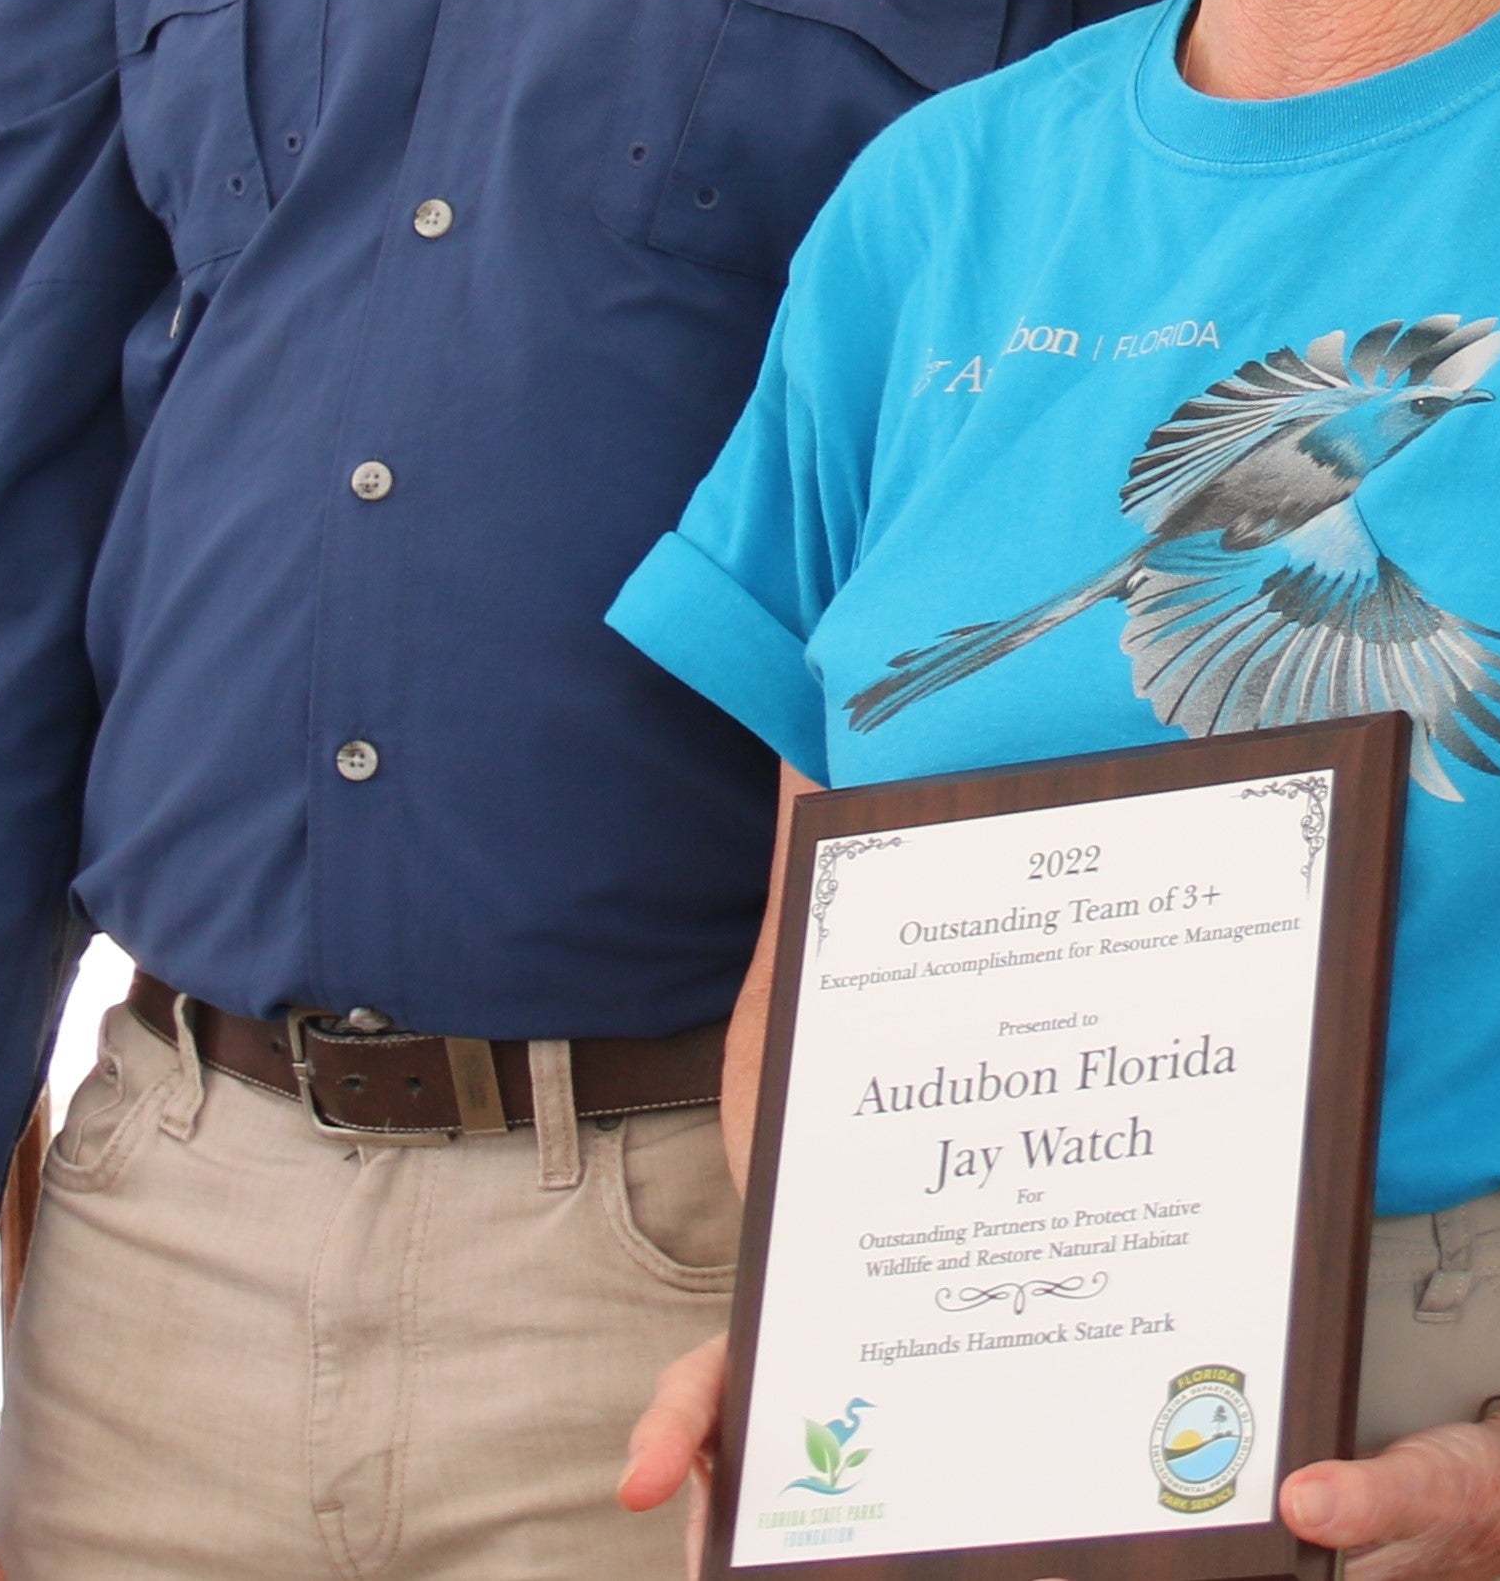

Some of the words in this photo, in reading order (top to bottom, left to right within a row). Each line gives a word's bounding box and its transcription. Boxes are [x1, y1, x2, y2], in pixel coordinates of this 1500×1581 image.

[1113, 320, 1221, 361] FLORIDA
[1028, 845, 1101, 880] 2022
[899, 906, 1060, 946] Outstanding
[1069, 898, 1139, 924] Team
[1148, 885, 1178, 914] of
[1182, 884, 1221, 910] 3+
[819, 962, 918, 991] Exceptional
[922, 947, 1063, 976] Accomplishment
[1067, 941, 1094, 959] for
[1099, 933, 1179, 955] Resource
[1184, 916, 1300, 944] Management
[998, 1012, 1077, 1036] Presented
[1082, 1013, 1098, 1027] to
[852, 1060, 1058, 1116] Audubon
[1076, 1034, 1236, 1091] Florida
[924, 1138, 1004, 1195] Jay
[1019, 1115, 1154, 1169] Watch
[1017, 1188, 1044, 1205] For
[859, 1224, 967, 1250] Outstanding
[973, 1219, 1046, 1238] Partners
[1051, 1216, 1068, 1230] to
[1074, 1207, 1137, 1227] Protect
[1143, 1199, 1202, 1219] Native
[866, 1255, 932, 1278] Wildlife
[937, 1251, 970, 1270] and
[977, 1249, 1043, 1267] Restore
[1049, 1235, 1117, 1259] Natural
[1122, 1230, 1189, 1251] Habitat
[859, 1335, 960, 1366] Highlands
[966, 1324, 1068, 1352] Hammock
[1074, 1321, 1124, 1341] State
[1129, 1313, 1176, 1336] Park
[1178, 1369, 1237, 1389] FLORIDA
[811, 1505, 843, 1525] STATE
[847, 1502, 884, 1521] PARKS
